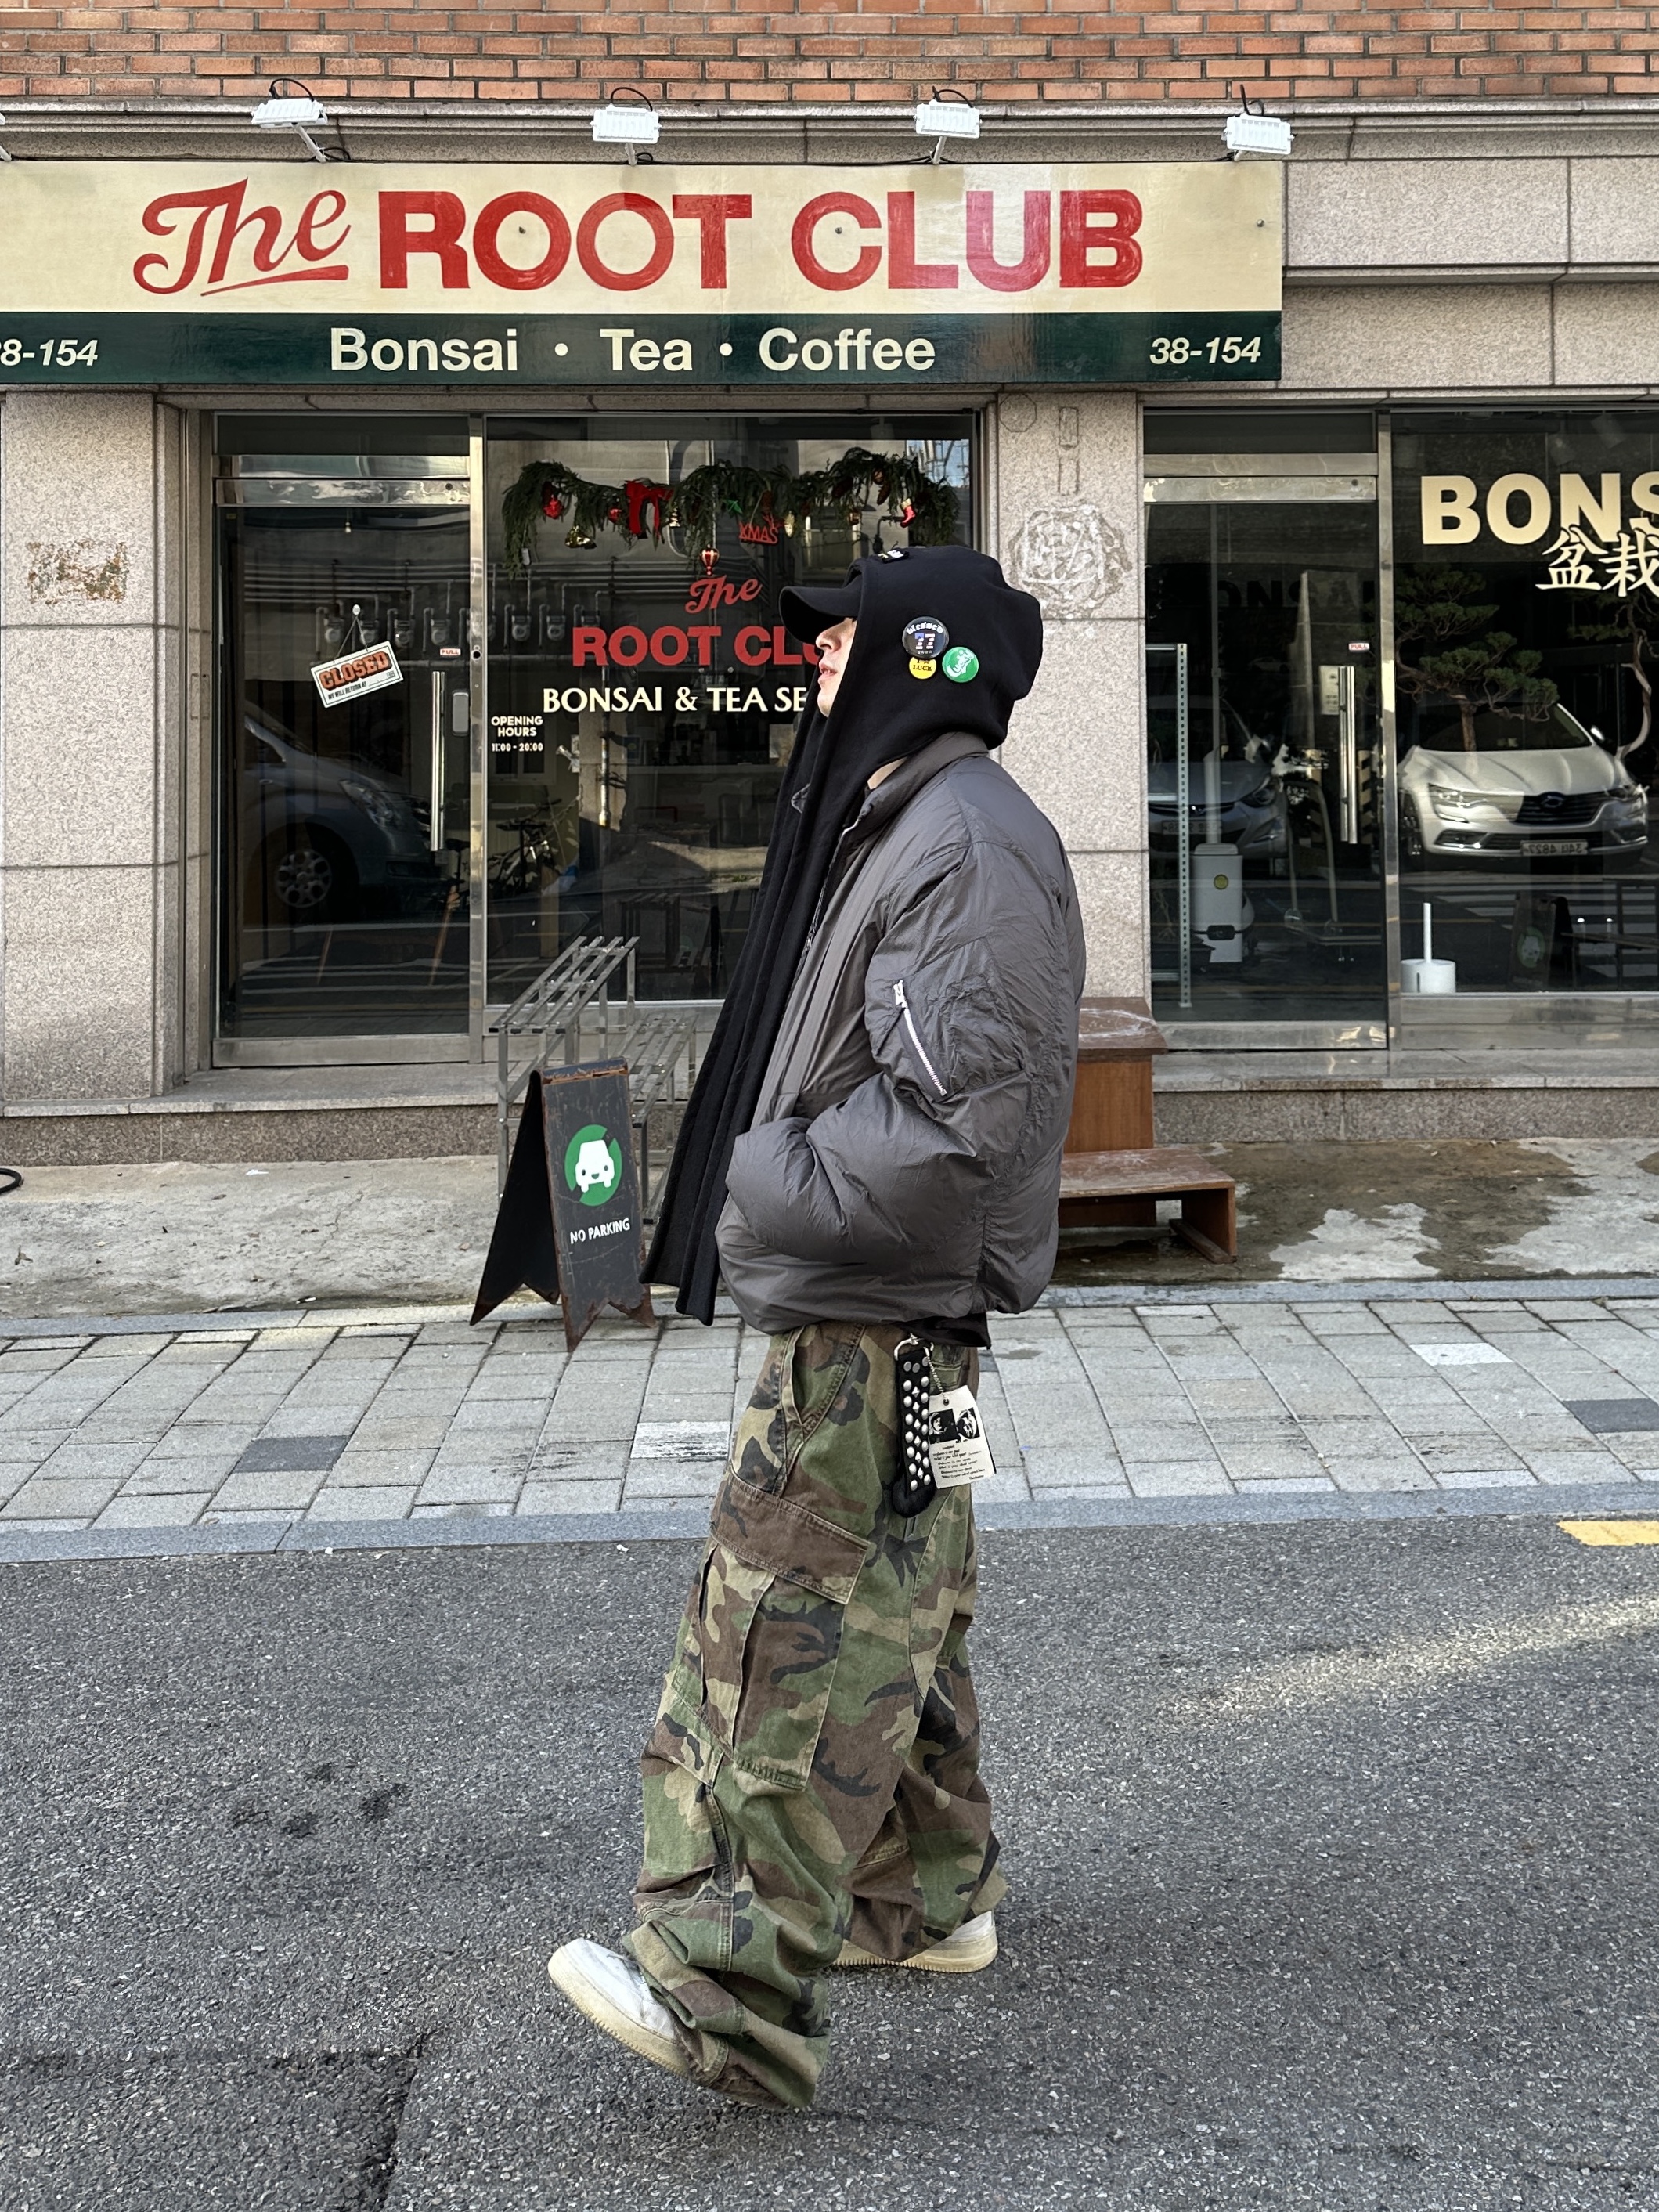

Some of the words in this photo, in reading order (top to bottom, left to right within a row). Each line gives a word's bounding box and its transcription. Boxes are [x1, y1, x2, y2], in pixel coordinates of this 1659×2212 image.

[132, 177, 352, 297] The
[379, 191, 752, 291] ROOT
[792, 189, 1143, 291] CLUB
[0, 339, 98, 366] 8-154
[330, 327, 518, 372] Bonsai
[600, 328, 692, 372] Tea
[759, 327, 936, 371] Coffee
[1149, 337, 1261, 365] 38-154
[739, 522, 779, 545] XMAS
[684, 575, 763, 614] The
[572, 626, 722, 666] ROOT
[914, 633, 936, 650] 77
[319, 651, 392, 691] CLOSED
[543, 687, 662, 713] BONSAI
[676, 687, 698, 712] &
[706, 687, 769, 712] TEA
[491, 716, 543, 726] OPENING
[498, 727, 537, 737] HOURS
[492, 742, 511, 752] 11:00
[518, 742, 543, 752] 20:00
[569, 1229, 586, 1244] NO
[588, 1218, 631, 1240] PARKING
